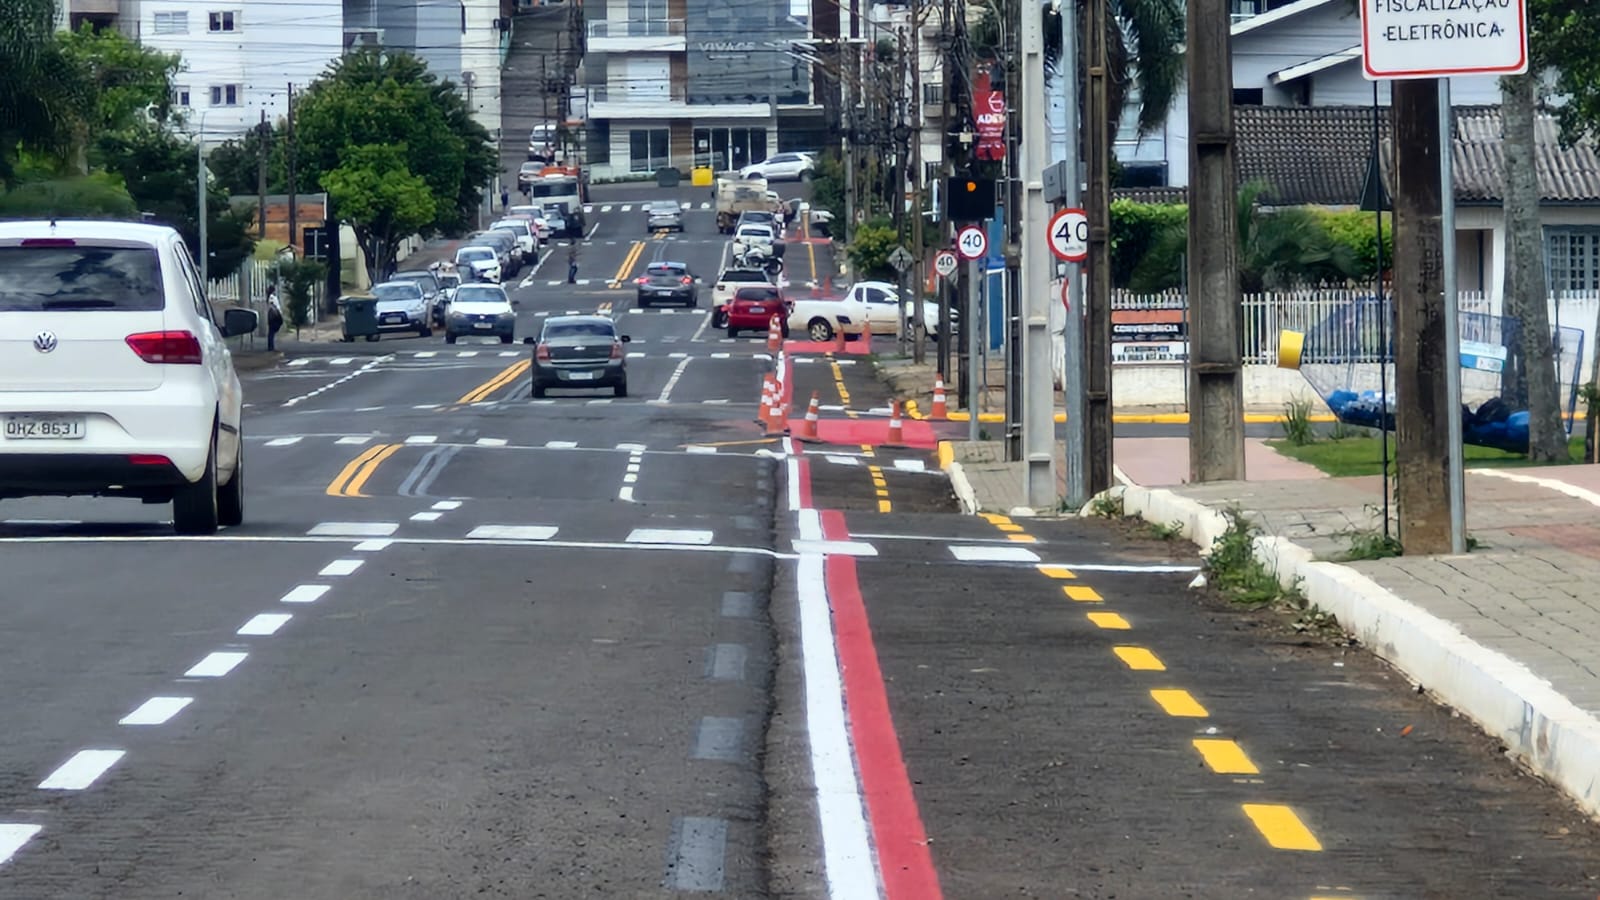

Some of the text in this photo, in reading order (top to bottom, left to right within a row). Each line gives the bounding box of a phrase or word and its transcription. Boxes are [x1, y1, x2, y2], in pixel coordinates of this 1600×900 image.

[1386, 19, 1501, 41] ELETRÔNICA
[962, 233, 982, 248] 40
[1055, 221, 1089, 244] 40
[938, 256, 953, 266] 40
